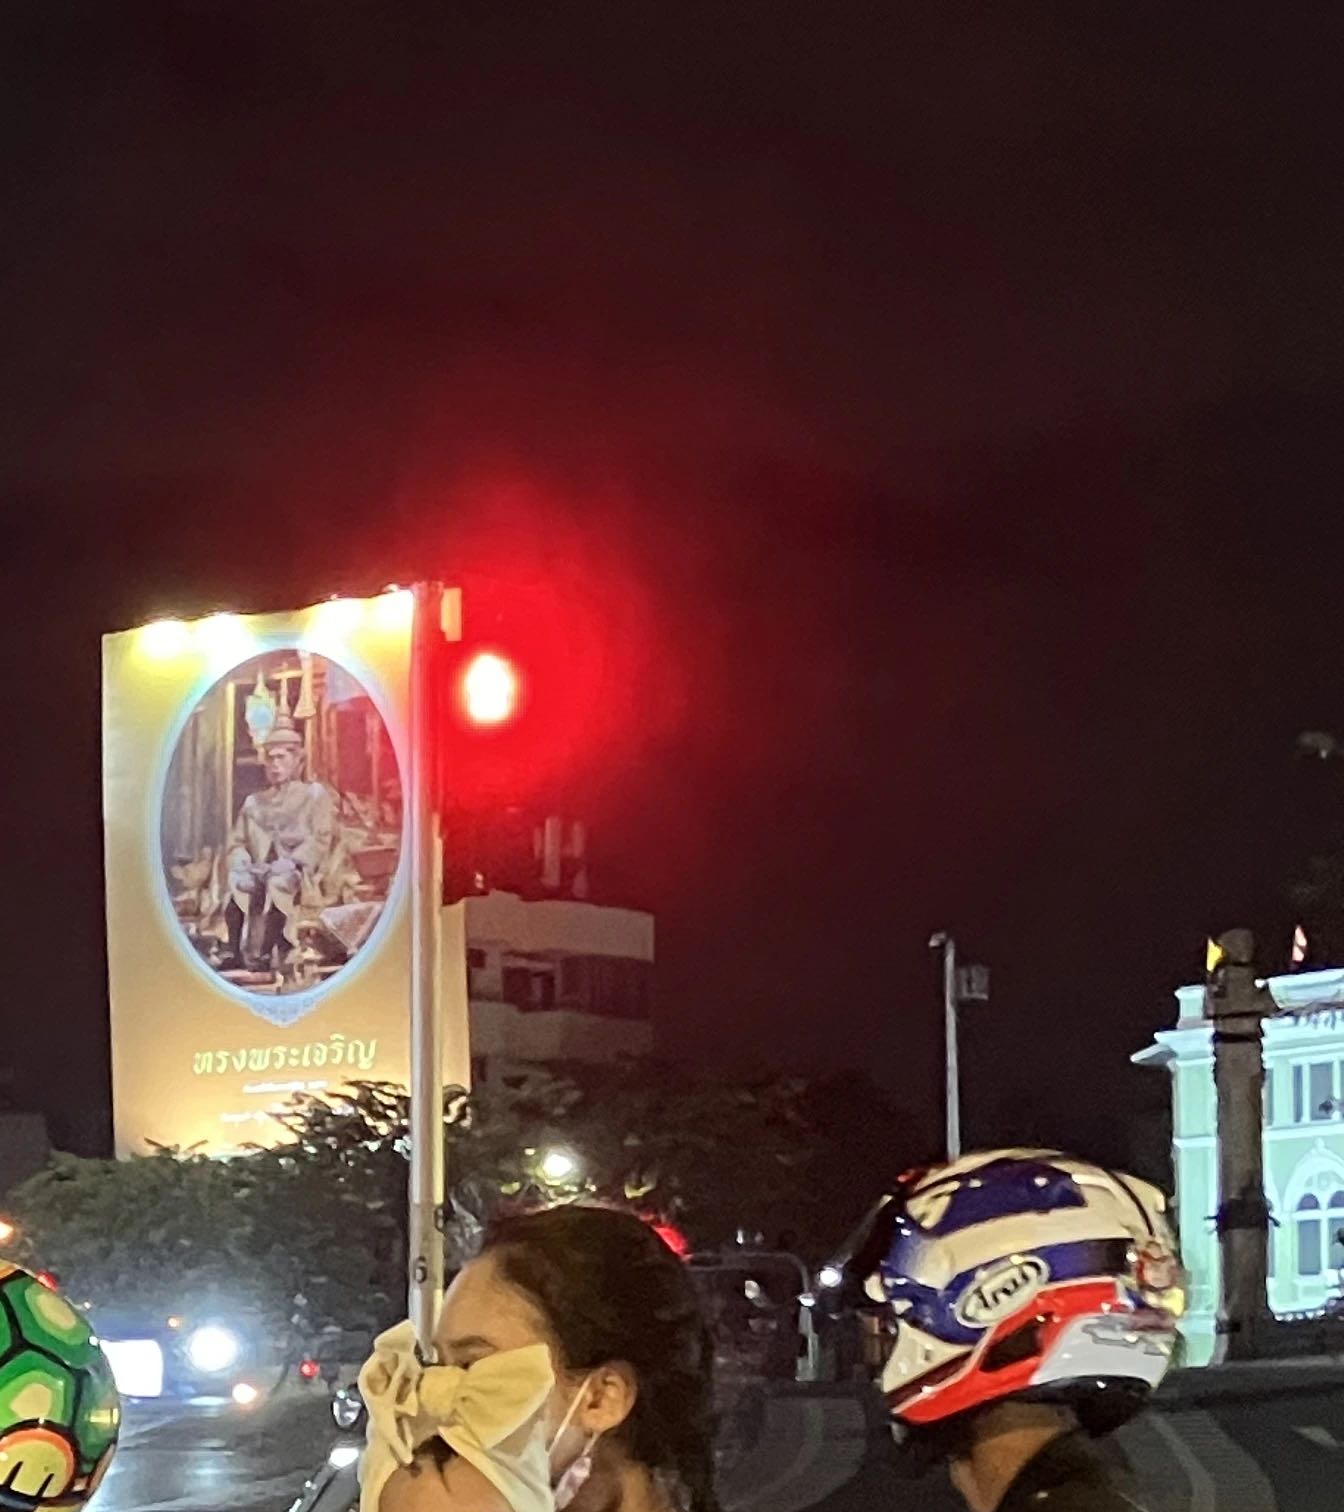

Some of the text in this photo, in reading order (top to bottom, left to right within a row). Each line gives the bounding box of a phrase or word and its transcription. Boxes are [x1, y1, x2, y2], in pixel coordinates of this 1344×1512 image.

[193, 1033, 377, 1075] ทรงพระเจริญ
